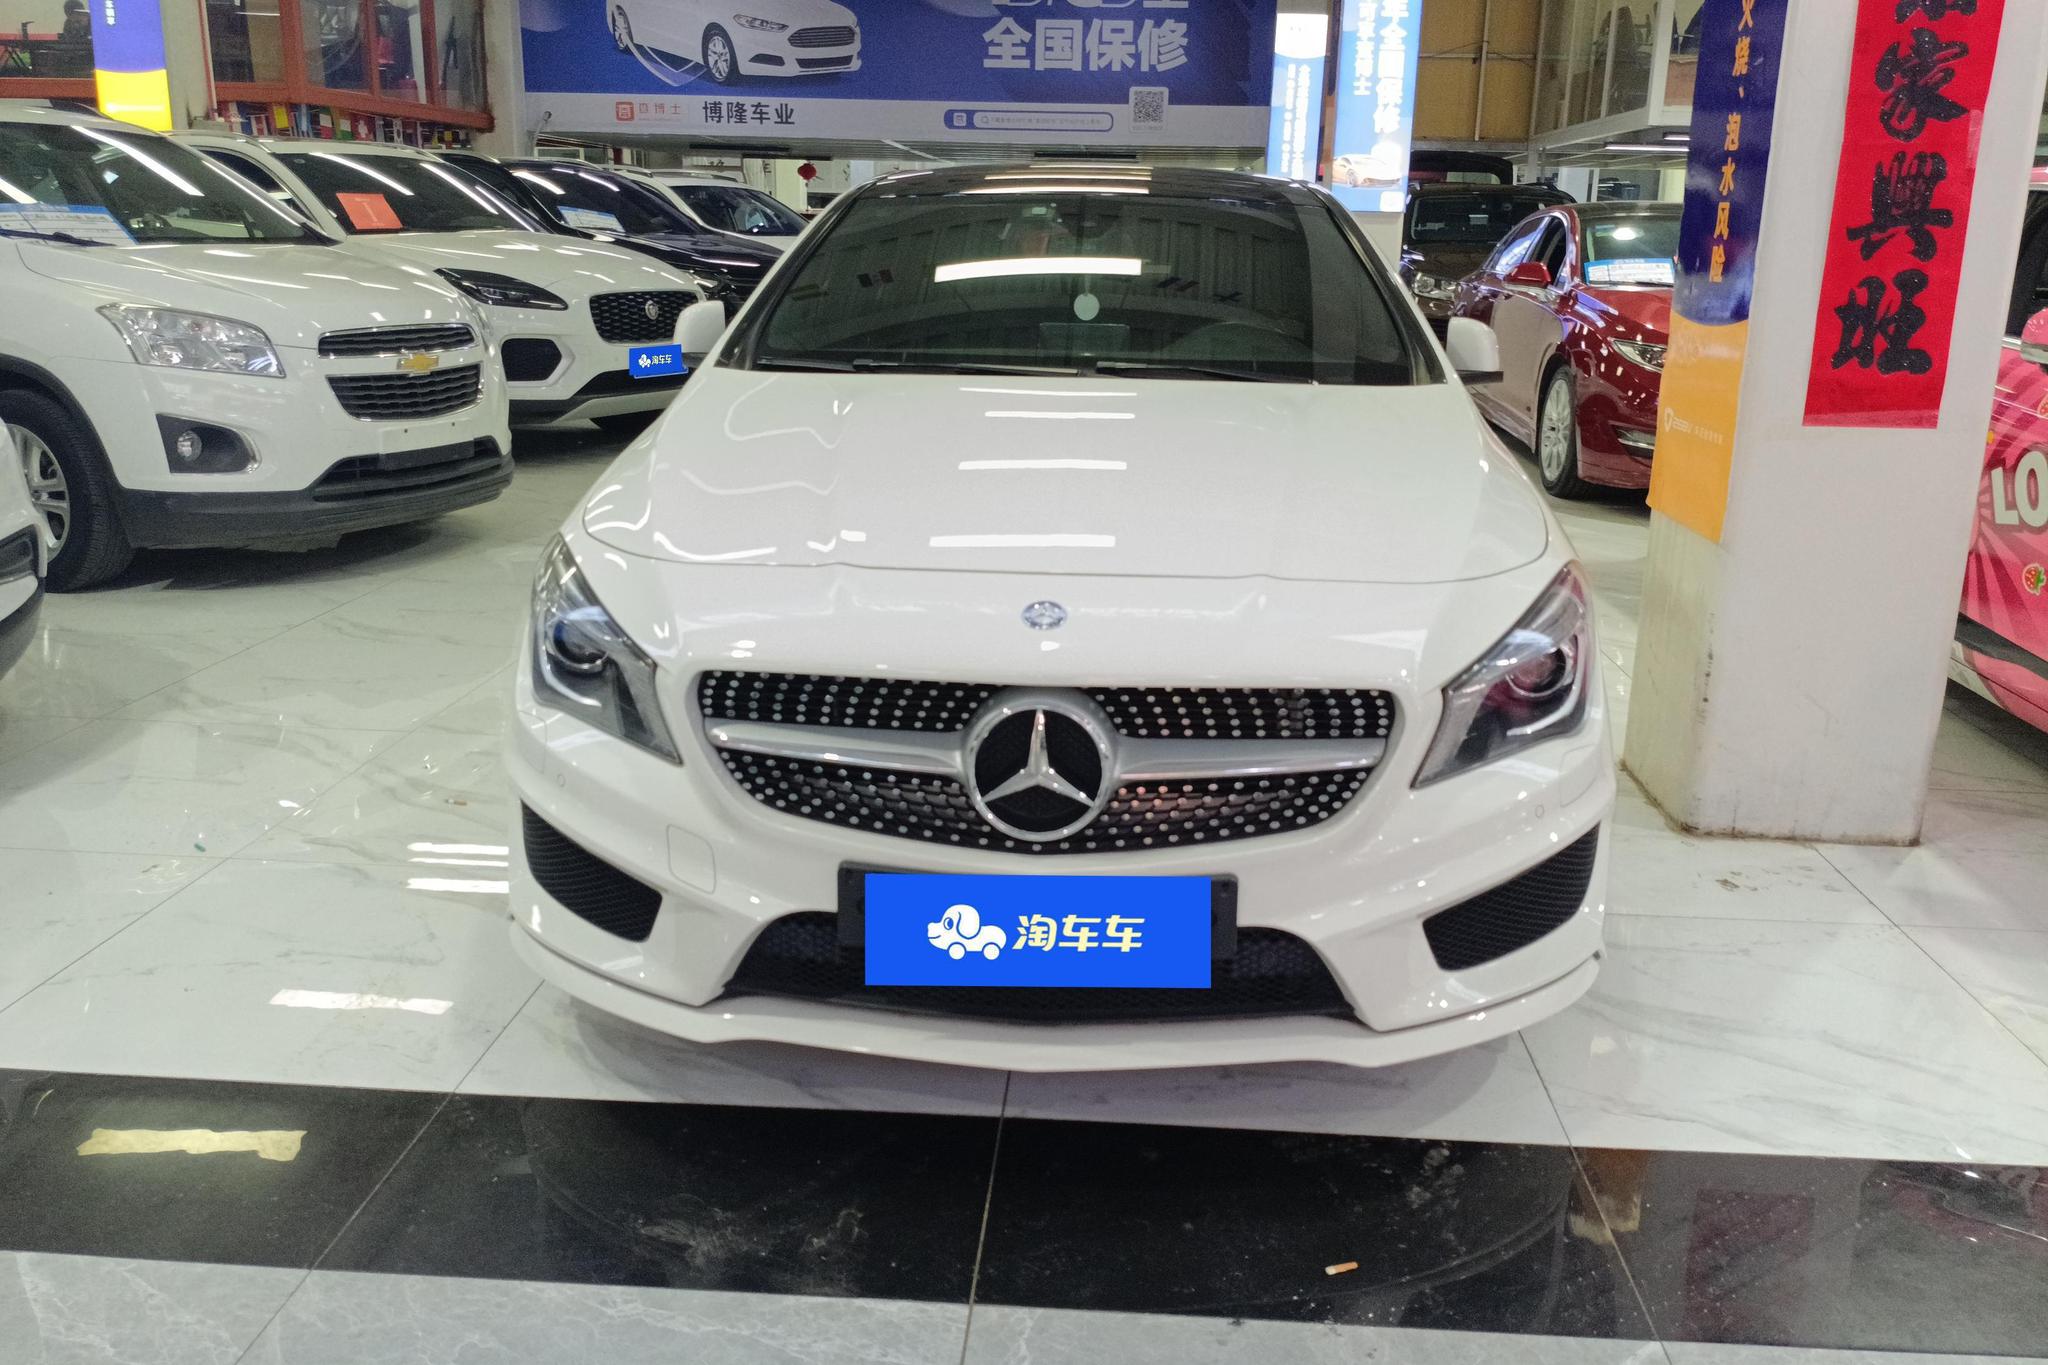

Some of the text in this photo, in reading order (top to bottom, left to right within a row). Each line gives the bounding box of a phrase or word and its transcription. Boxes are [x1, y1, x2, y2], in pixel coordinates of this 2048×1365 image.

[702, 100, 796, 125] 博隆车业
[982, 17, 1189, 72] 全国保修
[1709, 0, 1754, 283] 火烧、泡水风险
[1831, 0, 1978, 375] 家興旺
